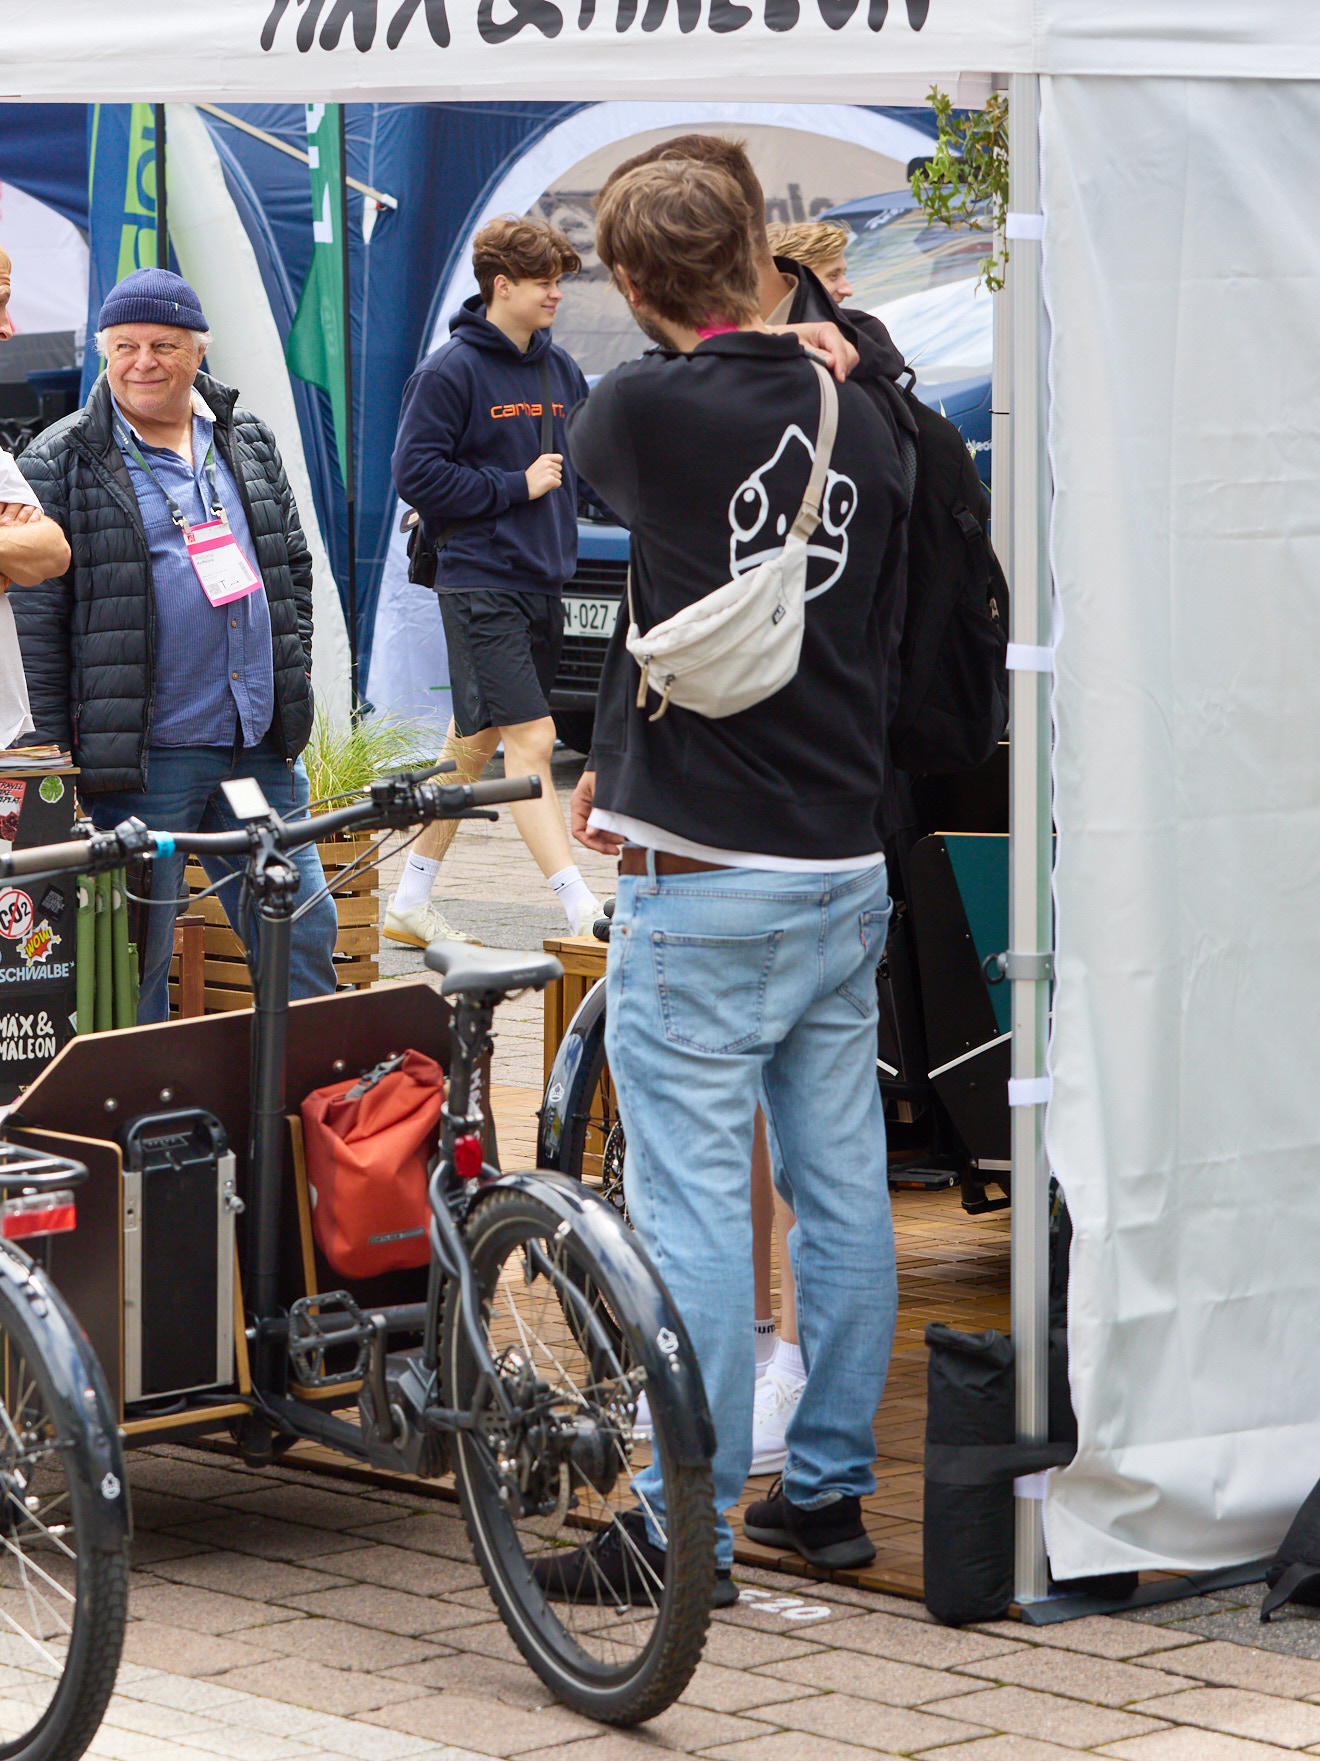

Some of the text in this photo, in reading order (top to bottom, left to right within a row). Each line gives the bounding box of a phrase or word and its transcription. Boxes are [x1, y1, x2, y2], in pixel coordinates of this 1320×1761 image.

[490, 401, 565, 419] carhatt
[24, 928, 52, 958] WOW!
[36, 1010, 55, 1036] &
